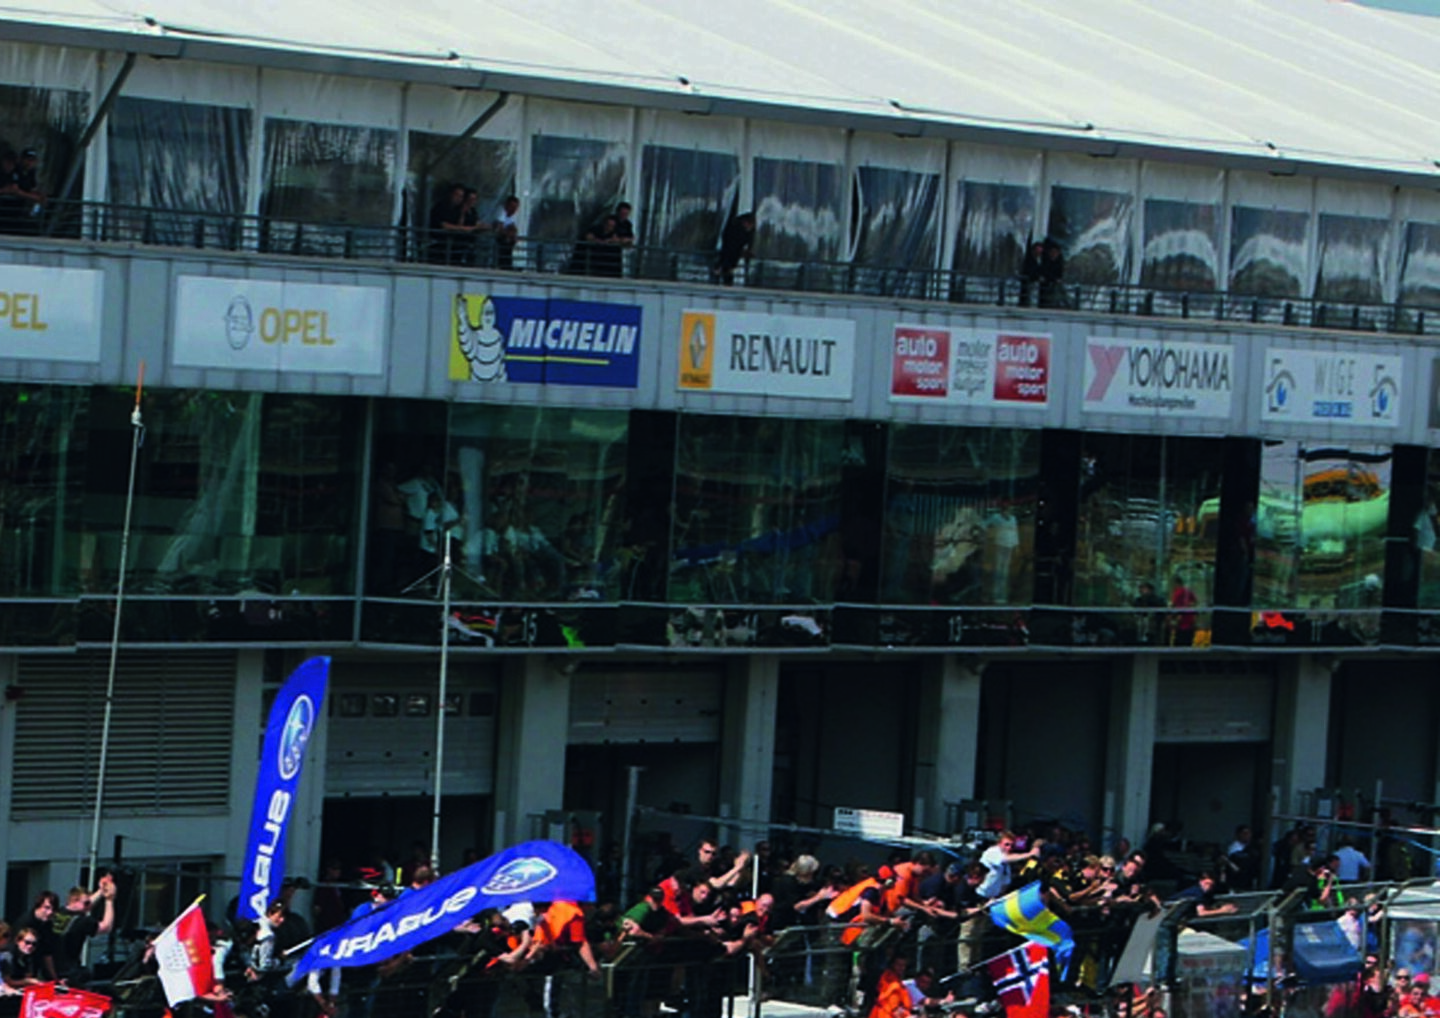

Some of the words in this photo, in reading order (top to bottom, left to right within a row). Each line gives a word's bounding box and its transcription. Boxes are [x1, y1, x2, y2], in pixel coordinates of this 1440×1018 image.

[260, 307, 335, 346] OPEL
[508, 318, 638, 355] MICHELIN
[730, 334, 837, 376] RENAULT
[1129, 348, 1231, 391] YOKOHAMA
